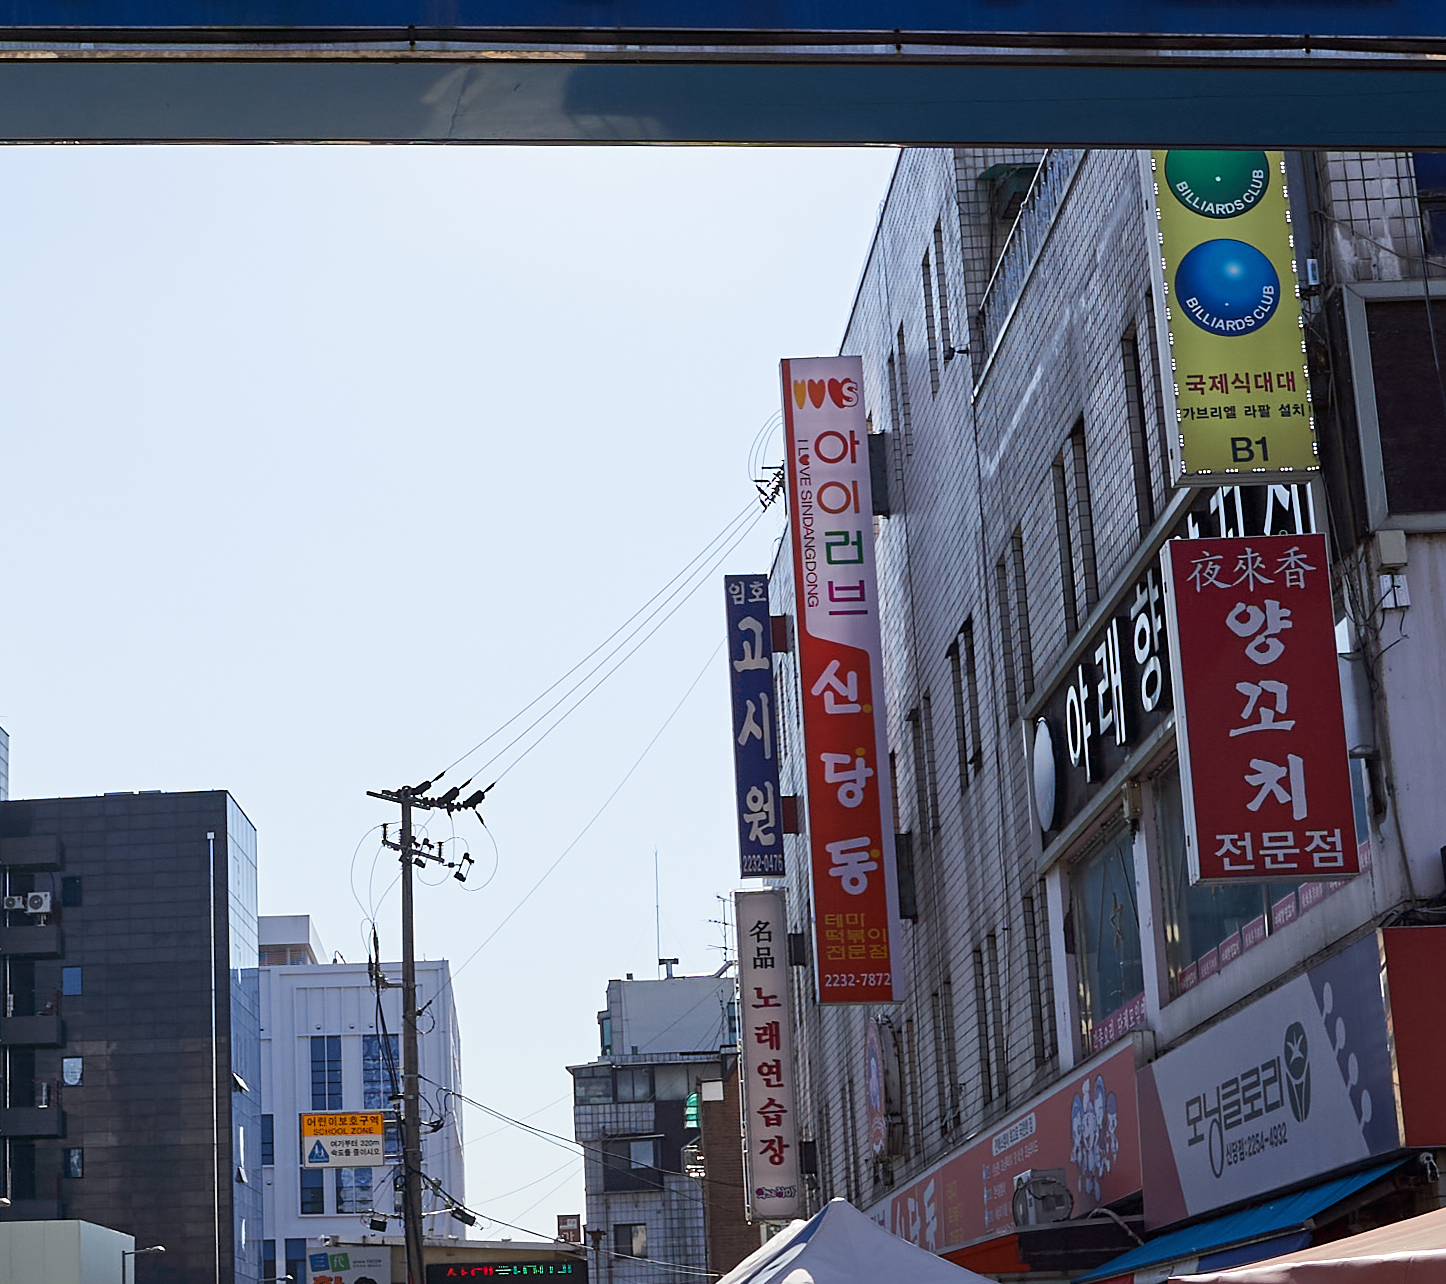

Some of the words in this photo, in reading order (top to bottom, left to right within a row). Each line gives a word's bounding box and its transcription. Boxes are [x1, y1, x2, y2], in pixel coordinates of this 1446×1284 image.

[1176, 180, 1245, 216] BILLIARDS
[1243, 169, 1265, 205] CLUB
[1185, 296, 1255, 331] BILLIARDS
[1253, 284, 1275, 320] CLUB
[1185, 371, 1297, 396] 국제식대대
[1183, 404, 1237, 421] 가브리엘
[1244, 403, 1271, 419] 라팔
[1231, 436, 1270, 463] B1
[814, 430, 868, 616] 아이러브
[1187, 546, 1316, 592] 夜來香
[728, 580, 767, 605] 임호
[1065, 568, 1166, 784] 야래향
[1225, 598, 1309, 821] 양꼬치
[732, 616, 776, 846] 고시원
[811, 659, 878, 895] 신당동
[1215, 828, 1344, 873] 전문점
[825, 913, 866, 928] 테마
[825, 928, 888, 944] 떡볶이
[749, 919, 775, 969] 名品
[825, 944, 889, 961] 전문점
[825, 972, 891, 988] 2232-7872
[752, 987, 790, 1166] 노래연습장
[306, 1115, 380, 1128] 어린이보호구역
[313, 1126, 349, 1136] SCHOOL
[350, 1126, 375, 1135] ZONE
[1185, 1055, 1285, 1180] 모닝글로리
[330, 1138, 358, 1148] 여기부터
[331, 1148, 352, 1157] 속도를
